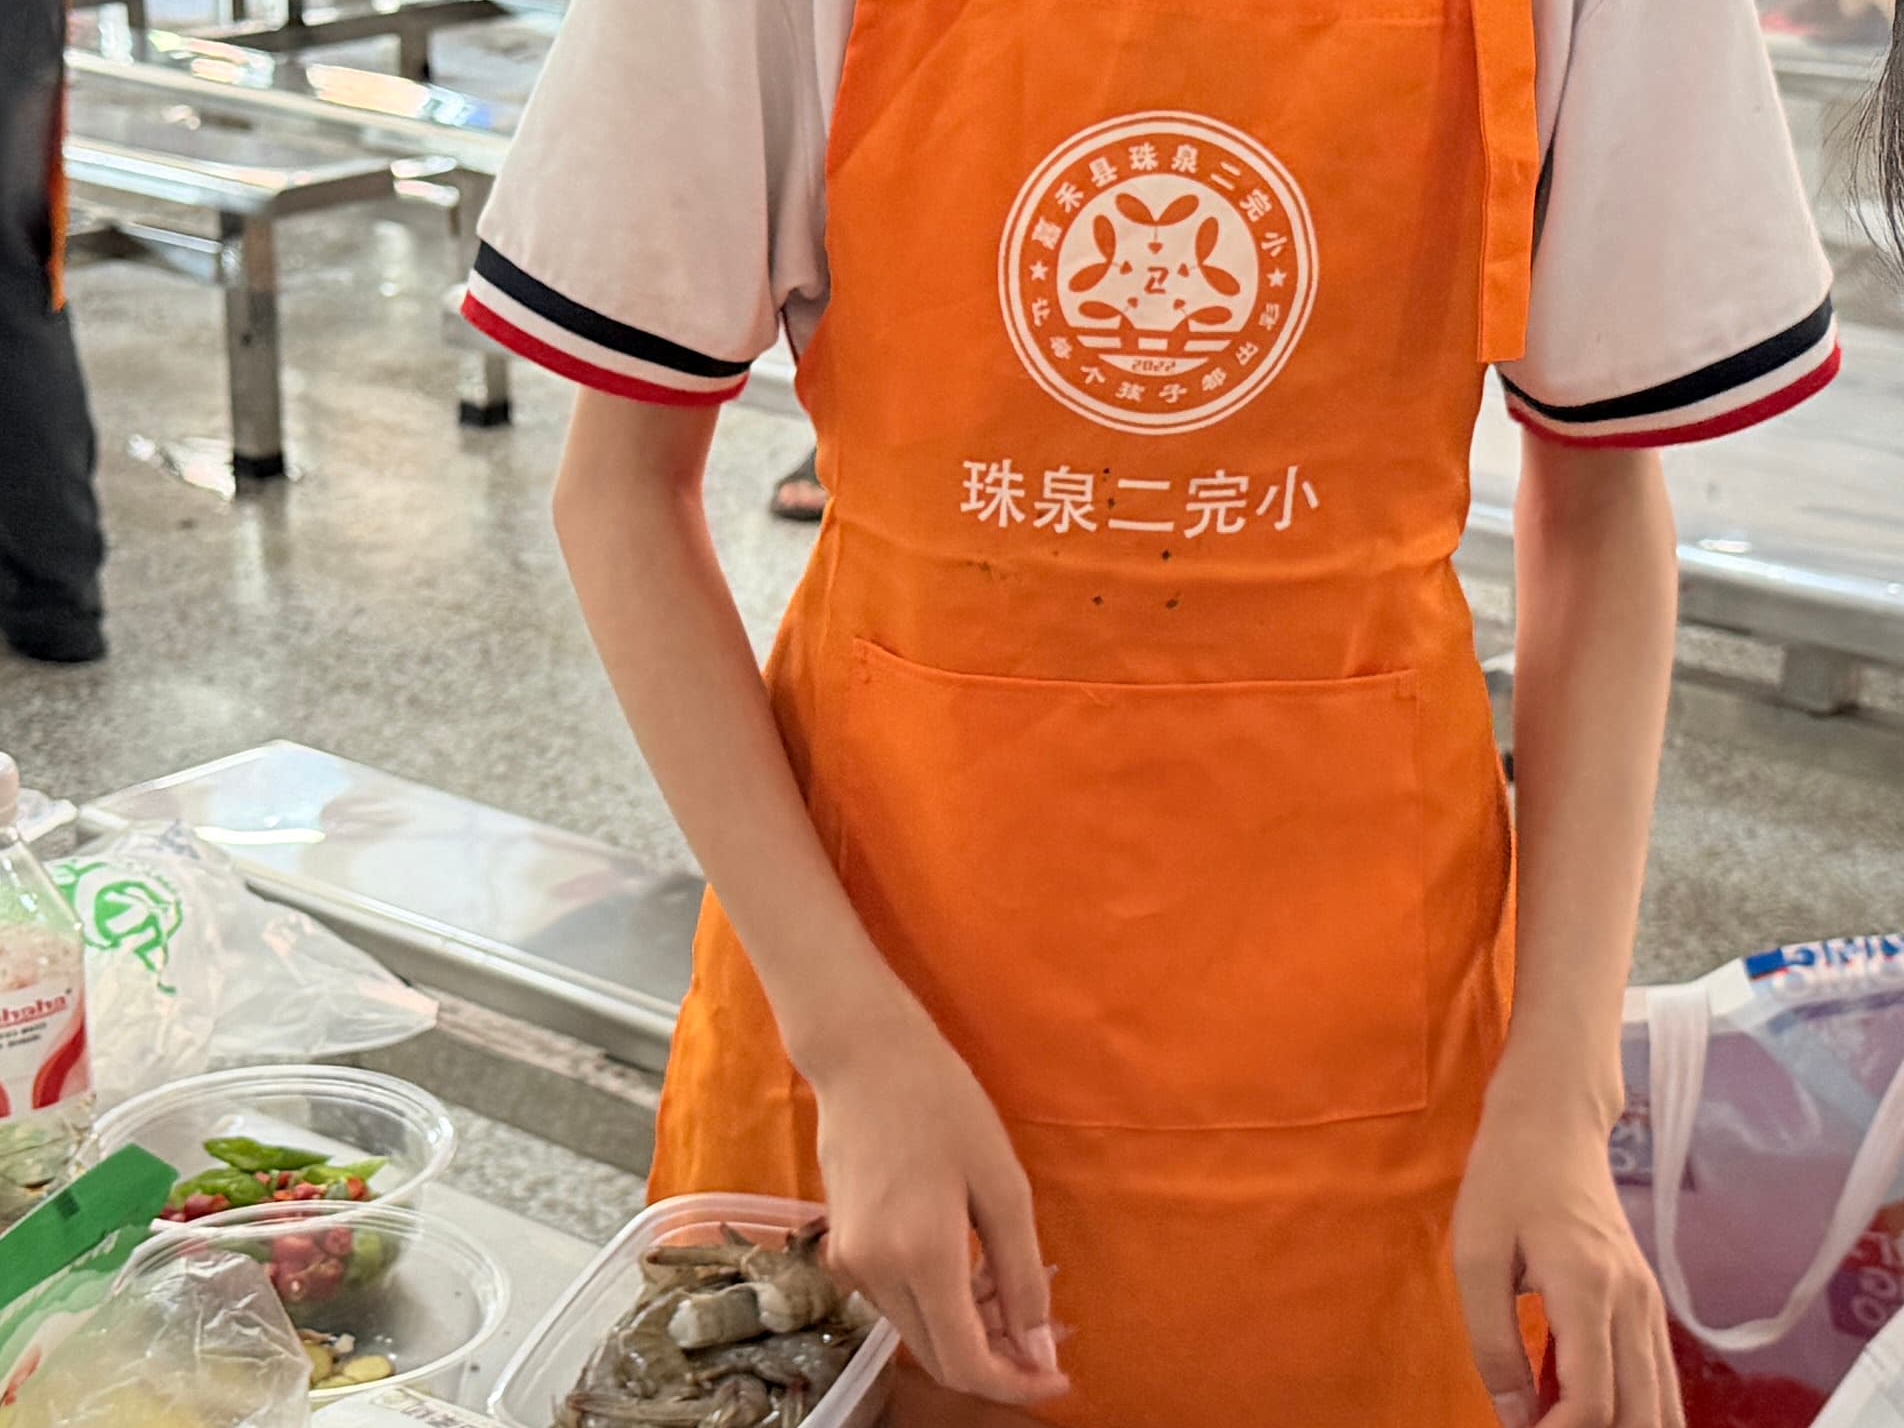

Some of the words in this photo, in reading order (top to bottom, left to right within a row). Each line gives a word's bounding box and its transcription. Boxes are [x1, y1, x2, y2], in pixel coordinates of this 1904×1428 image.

[1031, 141, 1289, 258] 嘉禾县珠泉二完小
[1030, 297, 1283, 405] 让每个孩子都出彩
[960, 458, 1320, 538] 珠泉二完小
